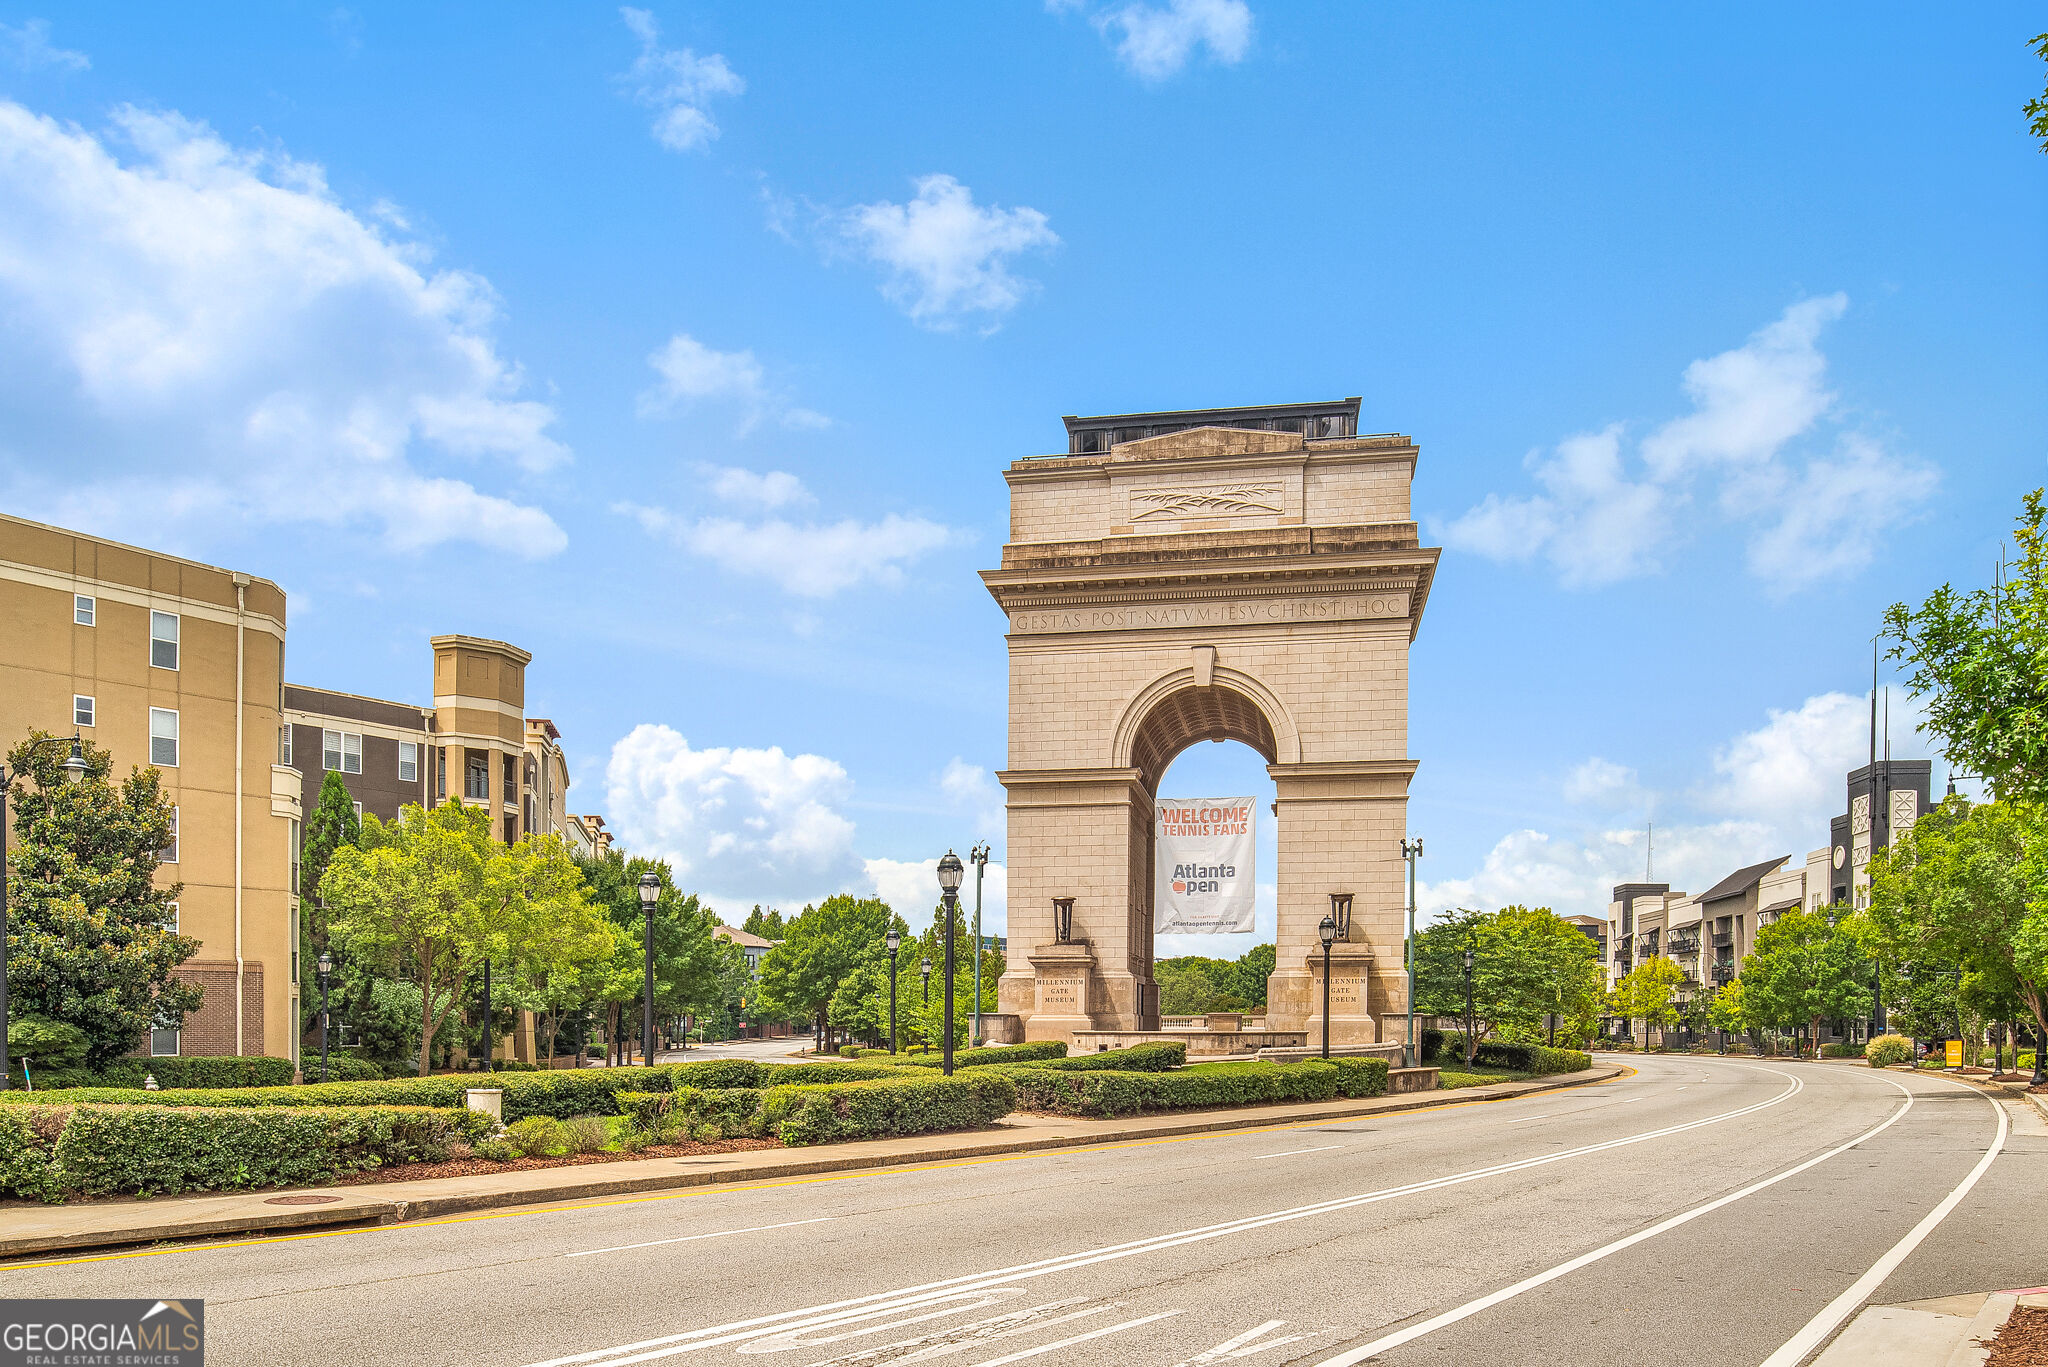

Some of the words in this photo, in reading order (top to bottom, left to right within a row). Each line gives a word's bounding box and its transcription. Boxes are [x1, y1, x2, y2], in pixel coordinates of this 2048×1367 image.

[1016, 613, 1081, 630] GESTAS
[1092, 610, 1139, 626] POST
[1145, 608, 1211, 624] NATVM
[1267, 601, 1346, 618] CHRISTI
[1356, 598, 1400, 615] HOC
[1162, 806, 1248, 824] WELCOME
[1162, 824, 1210, 836] TENNIS
[1213, 822, 1248, 836] FANS
[1173, 863, 1236, 879] Atlanta
[1172, 920, 1238, 928] atlantaopentennis.com
